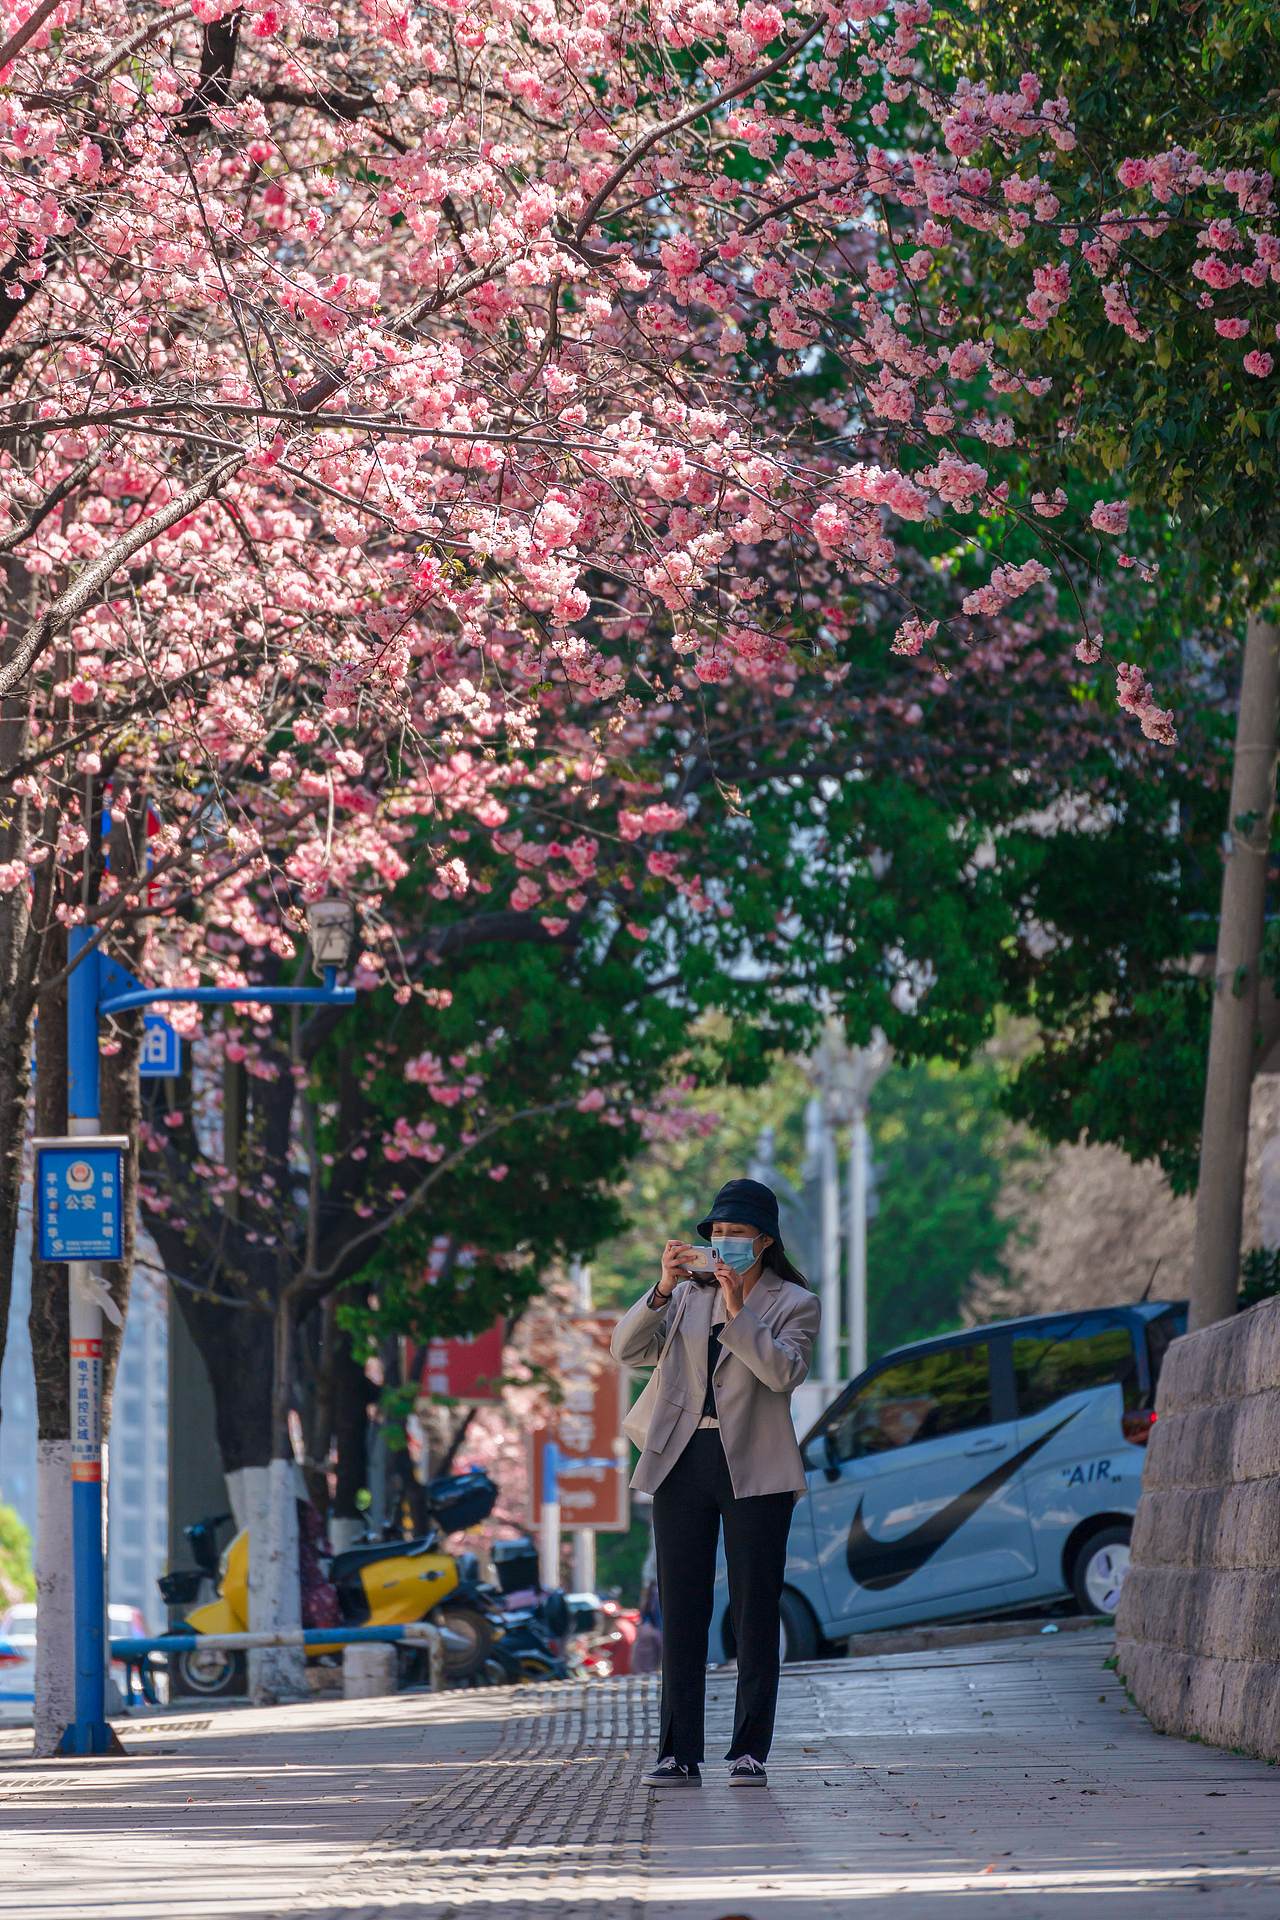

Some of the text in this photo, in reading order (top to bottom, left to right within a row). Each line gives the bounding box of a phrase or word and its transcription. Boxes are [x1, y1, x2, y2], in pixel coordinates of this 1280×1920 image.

[46, 1172, 59, 1199] 平安
[64, 1193, 97, 1210] 公安
[101, 1211, 114, 1238] 昆明
[76, 1359, 90, 1441] 电子监控区域
